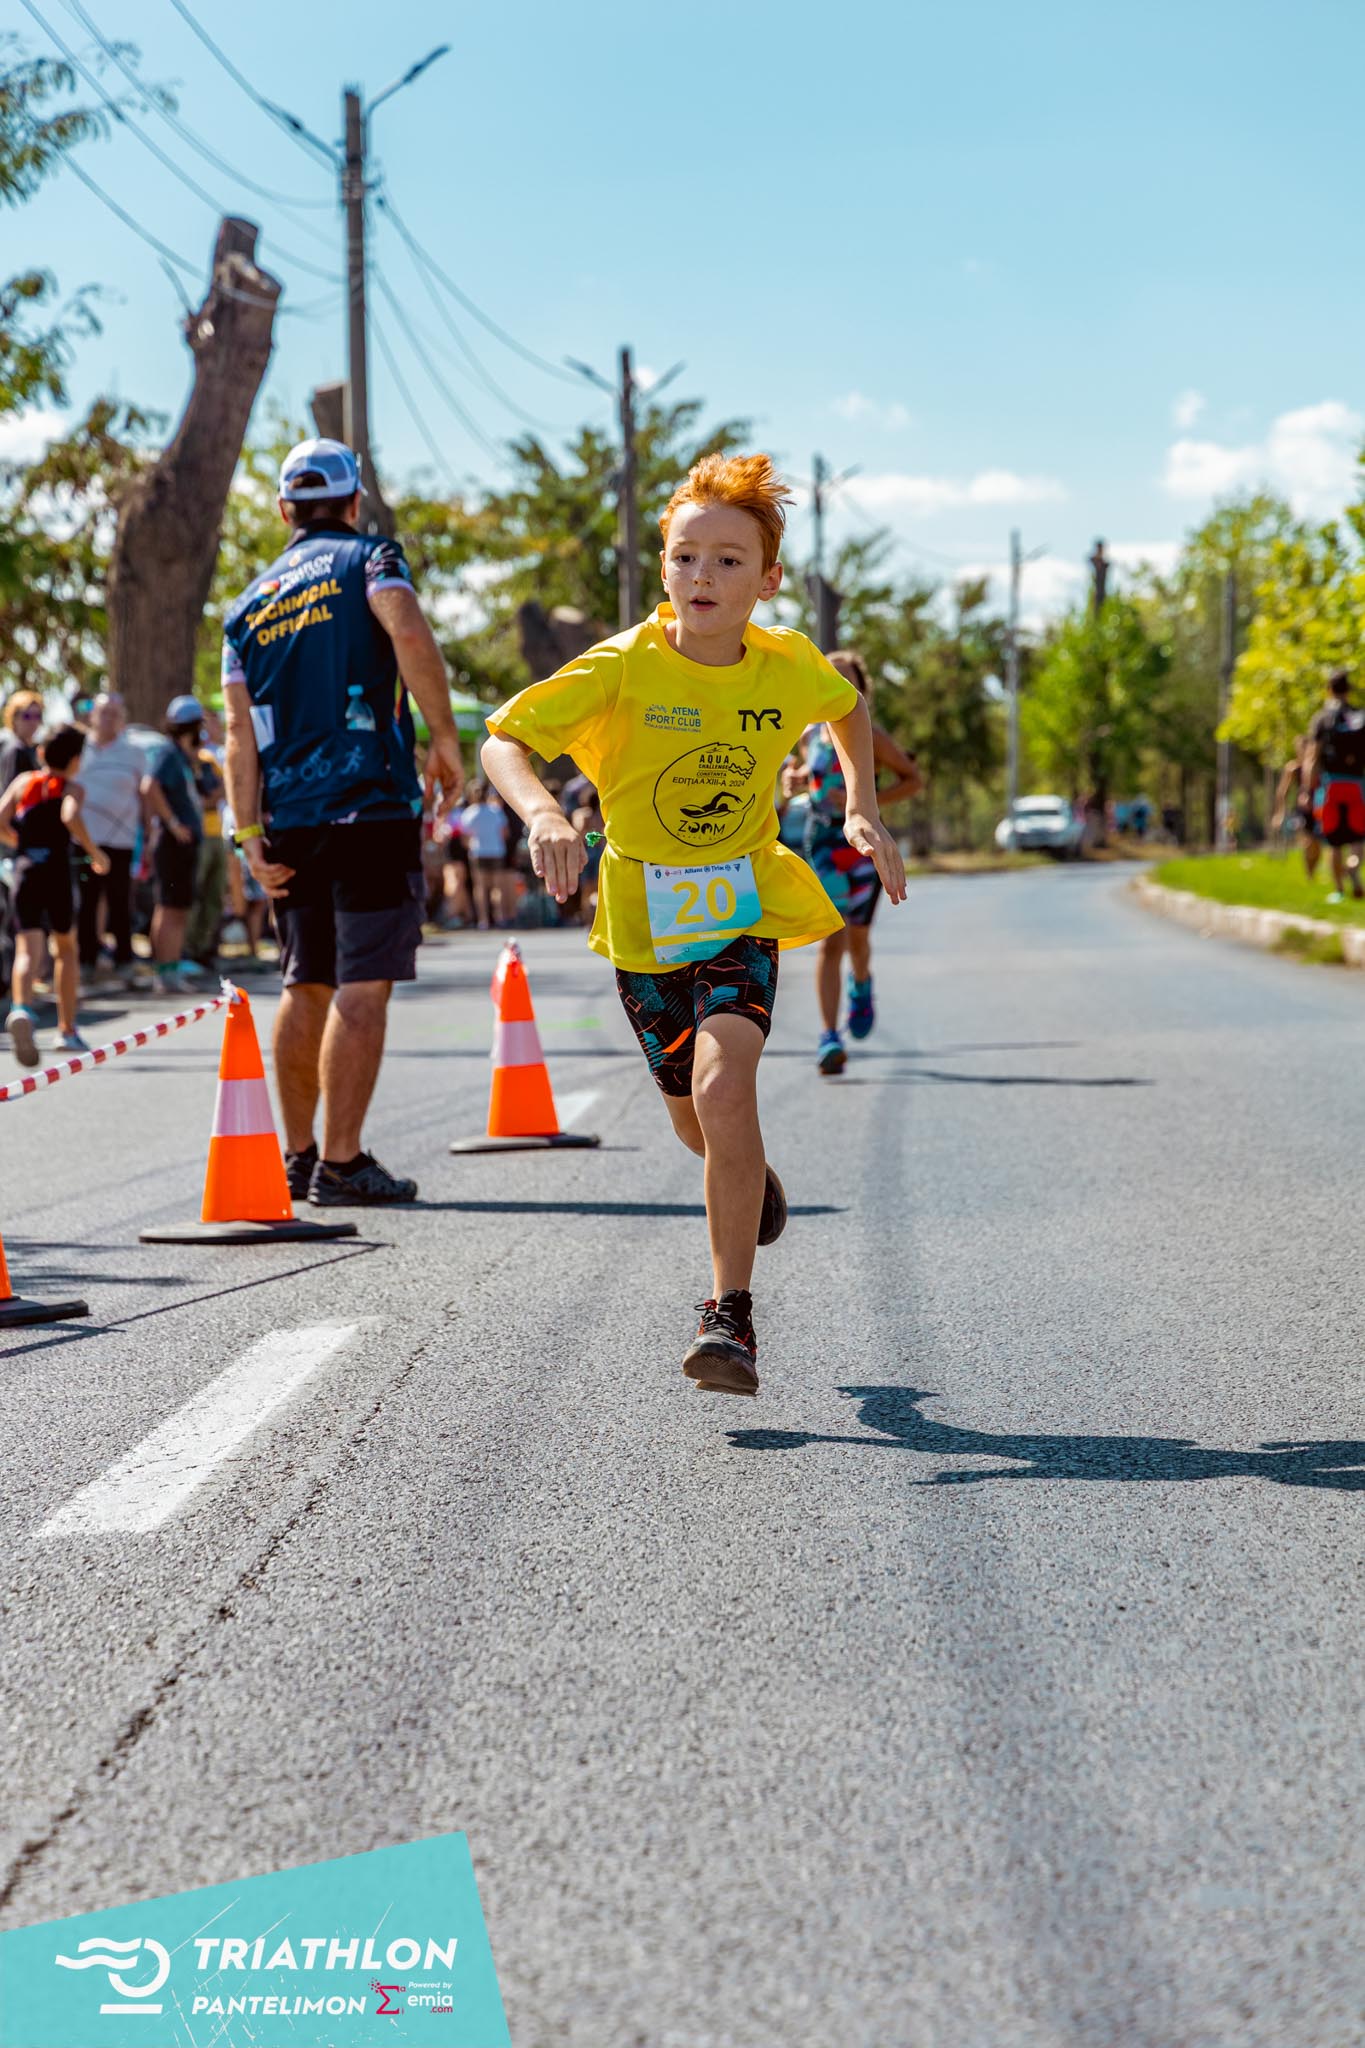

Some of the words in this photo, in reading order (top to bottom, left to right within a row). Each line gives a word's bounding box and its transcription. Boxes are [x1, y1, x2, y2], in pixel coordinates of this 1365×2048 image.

[671, 706, 700, 716] ATENA
[644, 713, 675, 725] SPORT
[677, 717, 701, 728] CLUB
[738, 708, 782, 732] TYR
[699, 754, 729, 764] AQUA
[728, 779, 745, 787] 2024
[678, 819, 726, 835] ZOOM
[671, 876, 737, 925] 20
